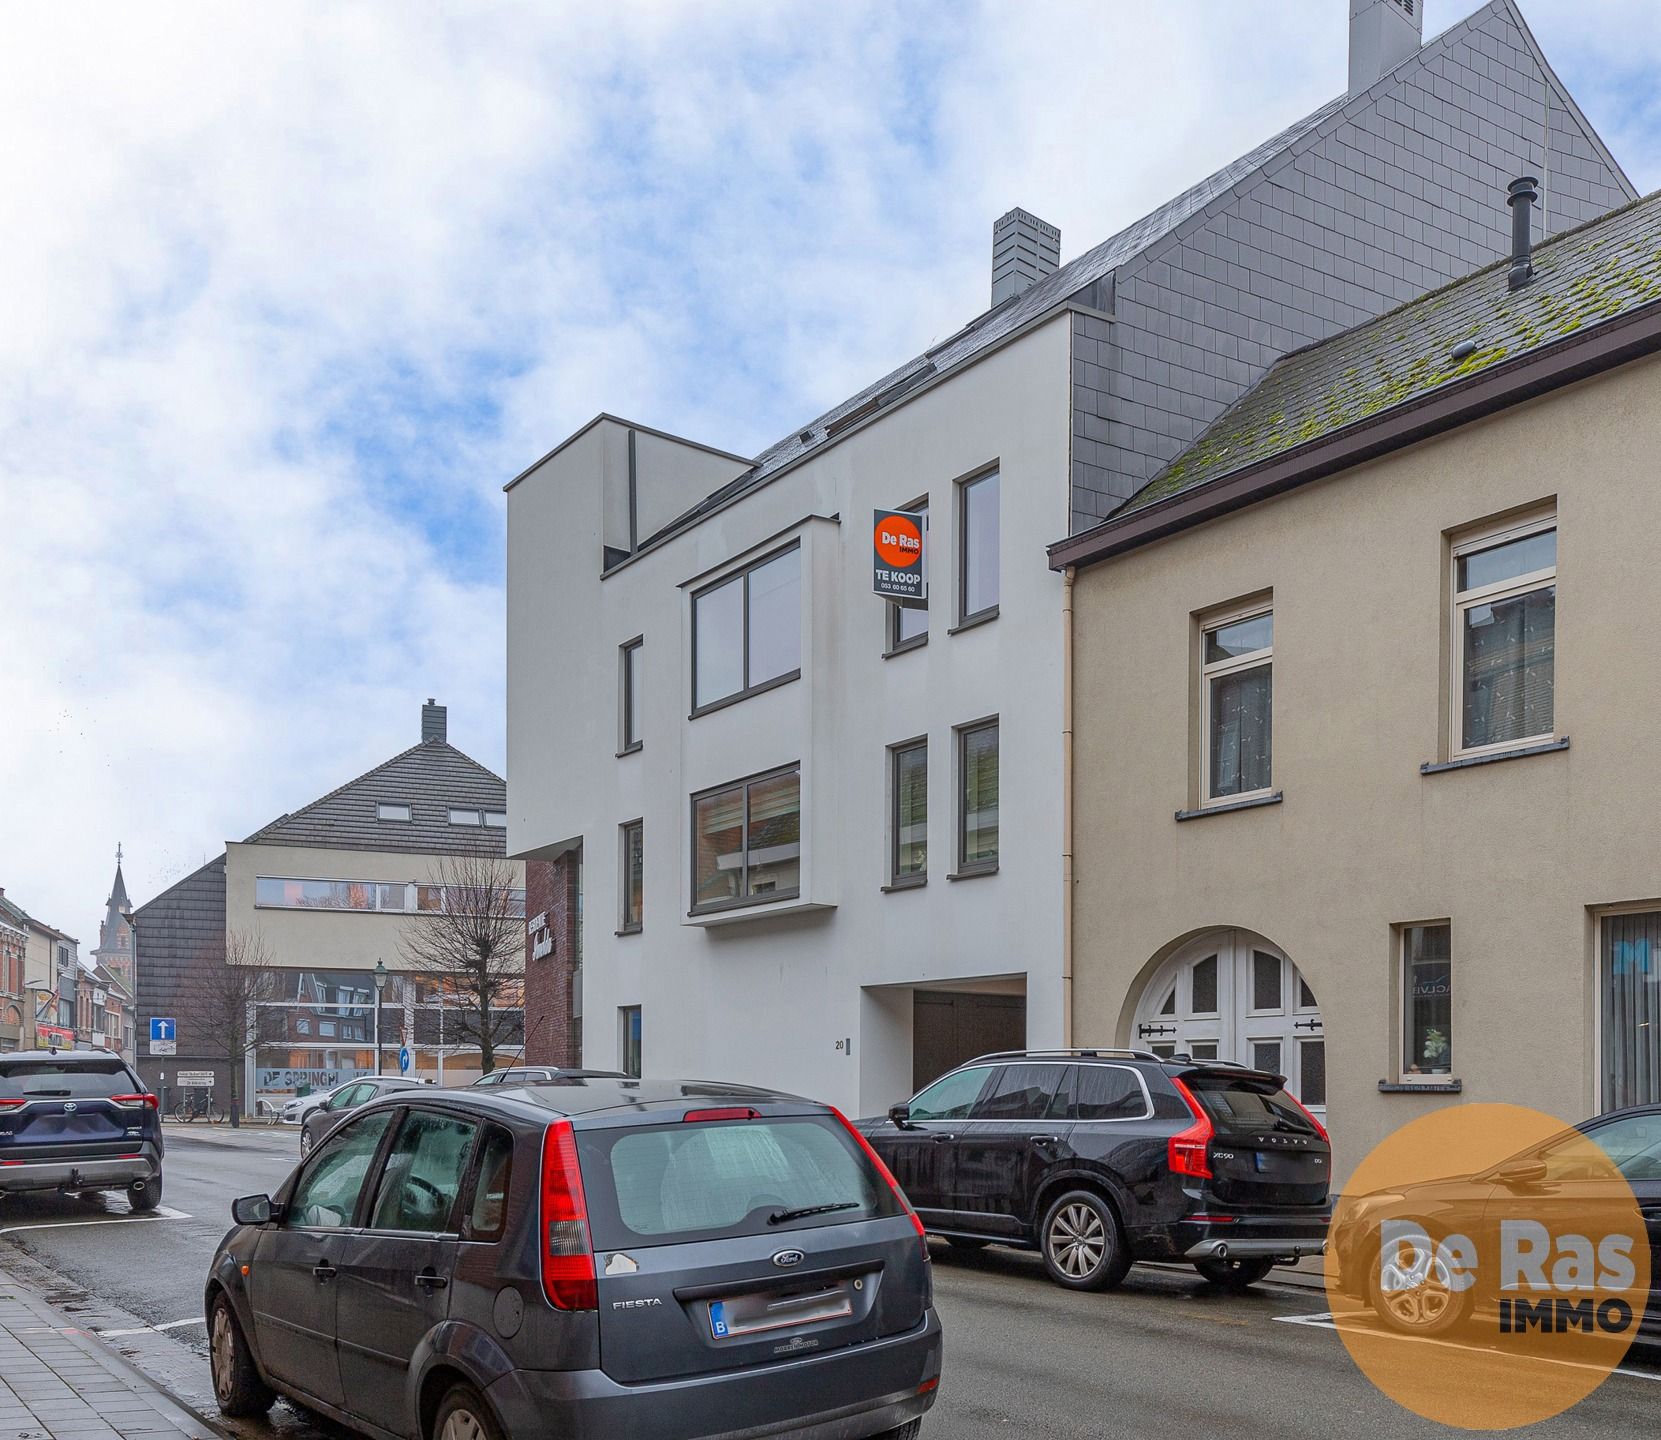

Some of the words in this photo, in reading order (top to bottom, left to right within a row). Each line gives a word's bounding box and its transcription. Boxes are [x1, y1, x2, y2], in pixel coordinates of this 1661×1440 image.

[881, 531, 897, 546] De
[899, 534, 920, 549] Ras
[899, 546, 919, 555] IMMO
[875, 569, 889, 581] TE
[890, 571, 921, 585] KOOP
[835, 1040, 844, 1050] 20
[263, 1071, 281, 1087] DE
[1258, 1136, 1308, 1145] VOLVO
[1213, 1151, 1234, 1160] XC90
[780, 1253, 799, 1264] Ford
[612, 1298, 662, 1310] FIESTA
[715, 1321, 726, 1334] B
